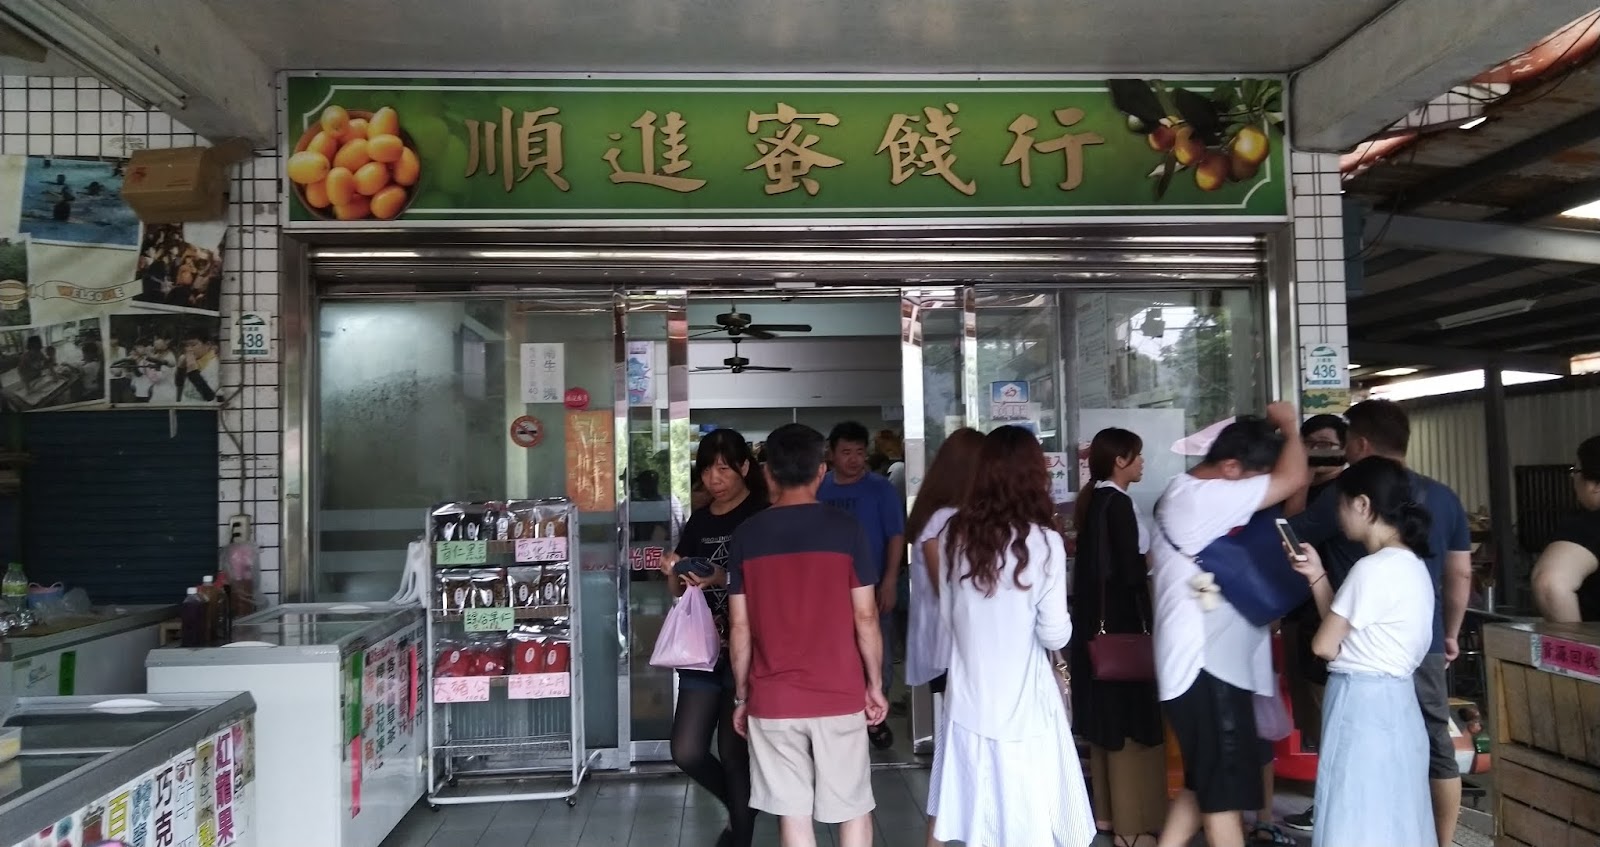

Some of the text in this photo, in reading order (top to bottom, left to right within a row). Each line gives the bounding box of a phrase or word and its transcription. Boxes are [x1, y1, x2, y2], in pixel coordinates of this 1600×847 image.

[464, 102, 1105, 196] 順進蜜餞行
[57, 285, 124, 300] WELCOME
[238, 333, 263, 347] 438
[1313, 364, 1337, 378] 436
[155, 766, 173, 847] 巧克
[216, 732, 234, 847] 紅龍果
